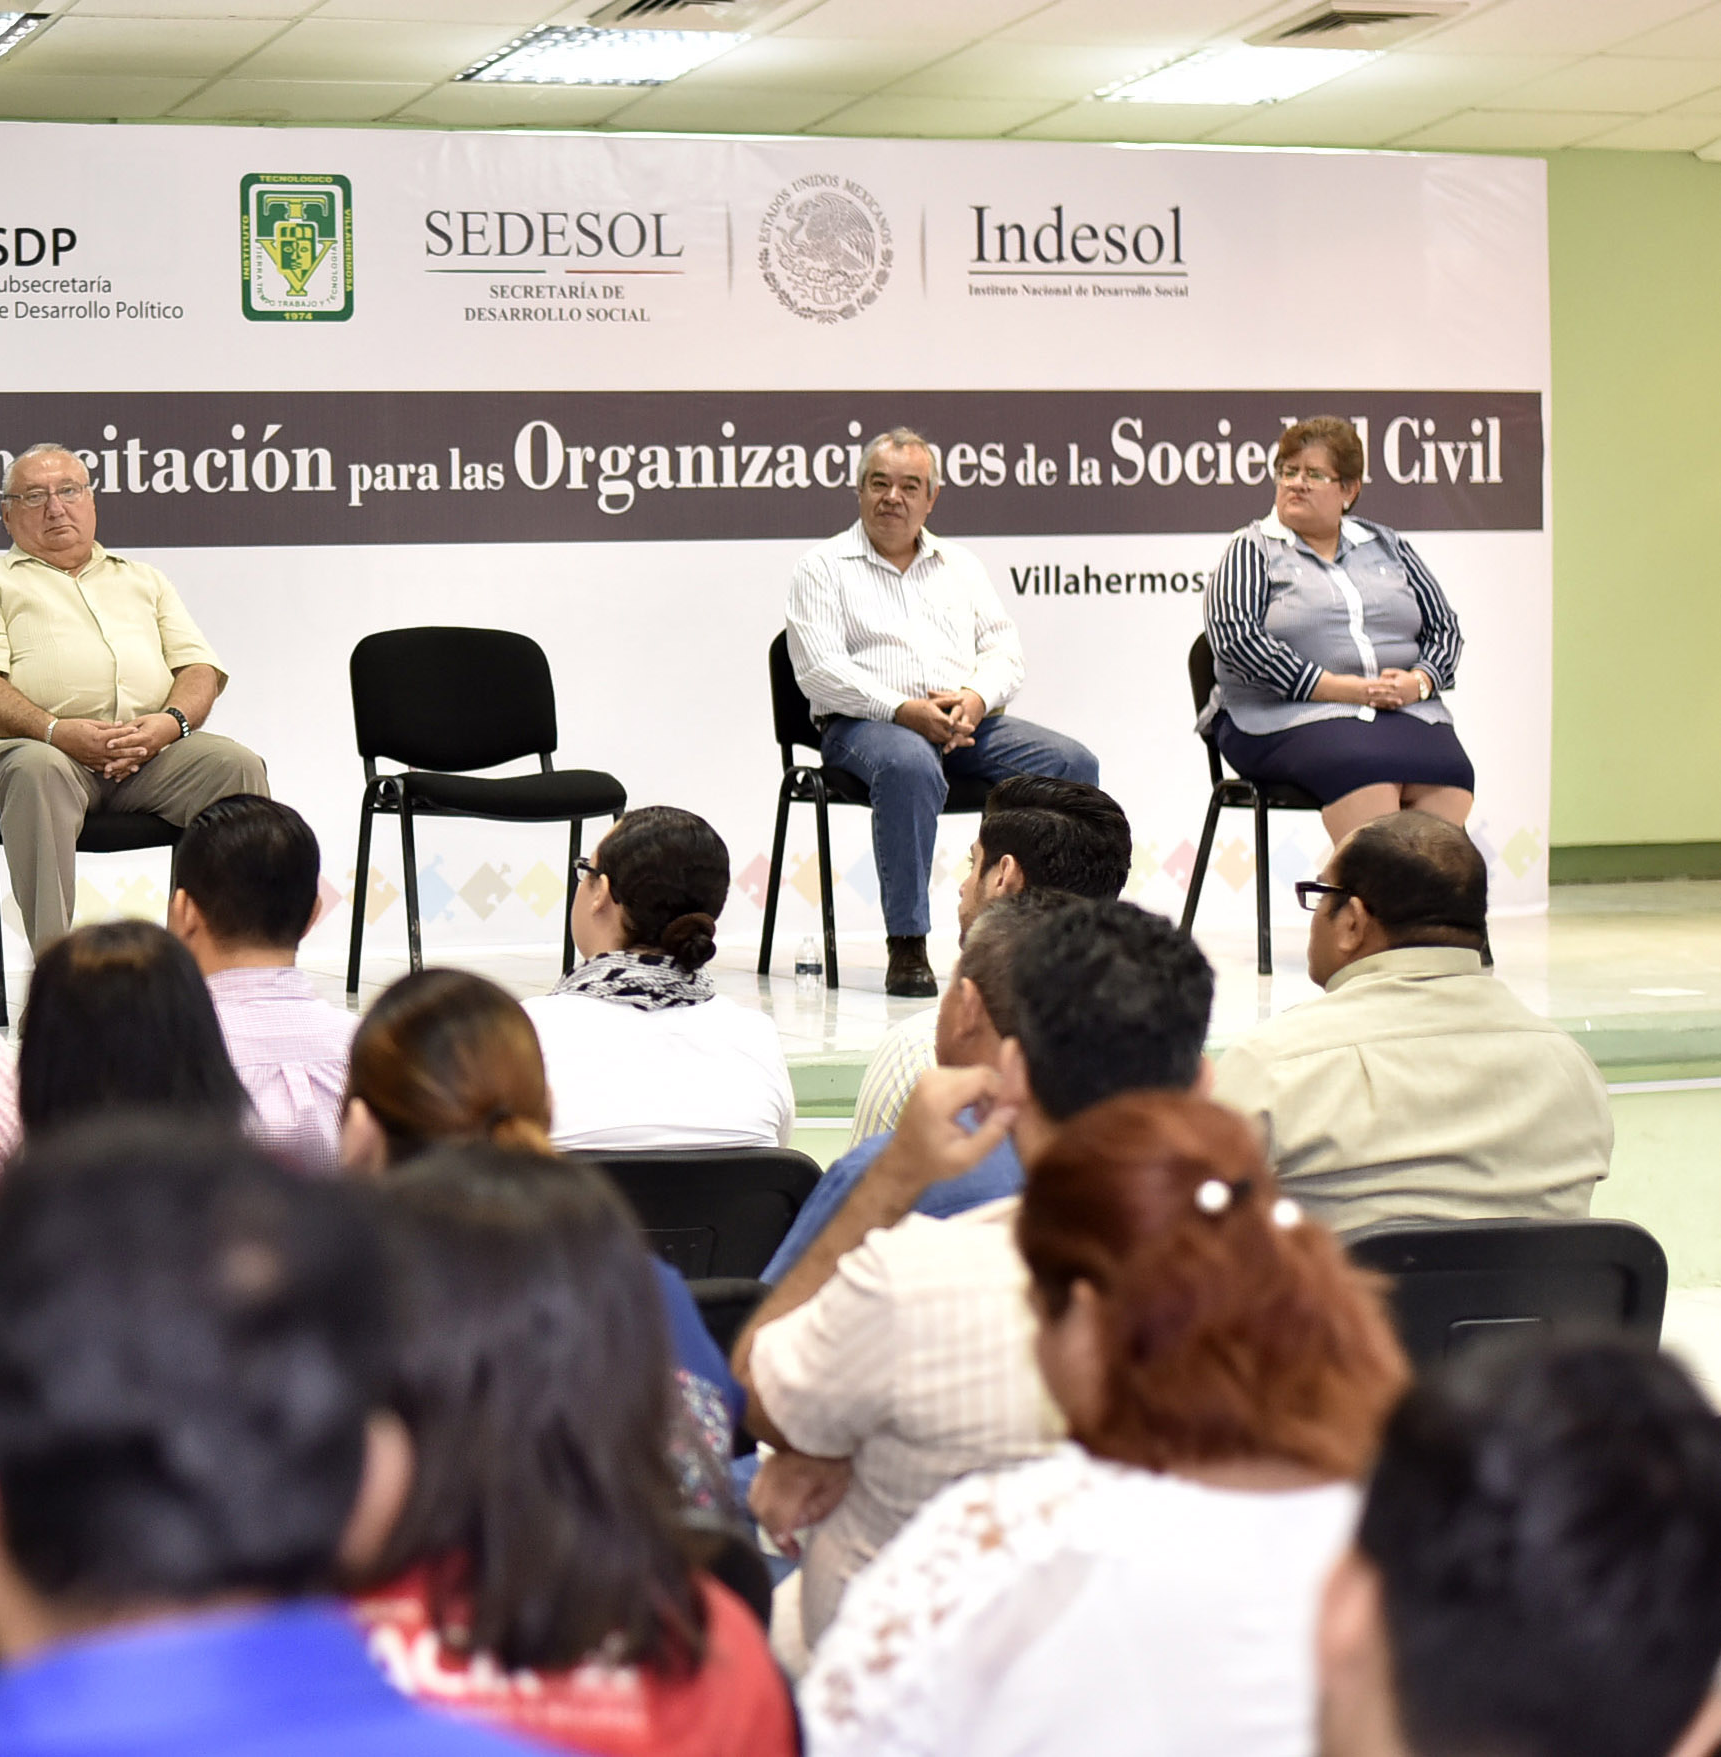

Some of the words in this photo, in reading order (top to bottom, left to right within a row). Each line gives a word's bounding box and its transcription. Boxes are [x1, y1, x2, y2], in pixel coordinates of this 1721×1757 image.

[259, 175, 334, 184] TECNOLOGICO
[758, 188, 791, 243] ESTADOS
[791, 174, 840, 192] UNIDOS
[425, 210, 684, 258] SEDESOL
[969, 204, 1186, 265] Indesol
[489, 282, 597, 299] SECRETARÍA
[602, 285, 625, 299] DE
[968, 284, 1018, 296] Instituto
[1022, 285, 1072, 296] Nacional
[1076, 285, 1088, 296] de
[1092, 285, 1152, 297] Desarrollo
[1155, 285, 1189, 297] Social
[15, 302, 111, 320] Desarrollo
[116, 301, 184, 320] Político
[283, 312, 313, 321] 1974
[464, 307, 582, 322] DESARROLLO
[586, 308, 650, 322] SOCIAL
[349, 463, 440, 505] para
[449, 449, 505, 490] las
[1015, 443, 1057, 486] de
[1068, 444, 1102, 485] la
[1383, 416, 1503, 484] Civil
[1010, 565, 1217, 596] Villahermos
